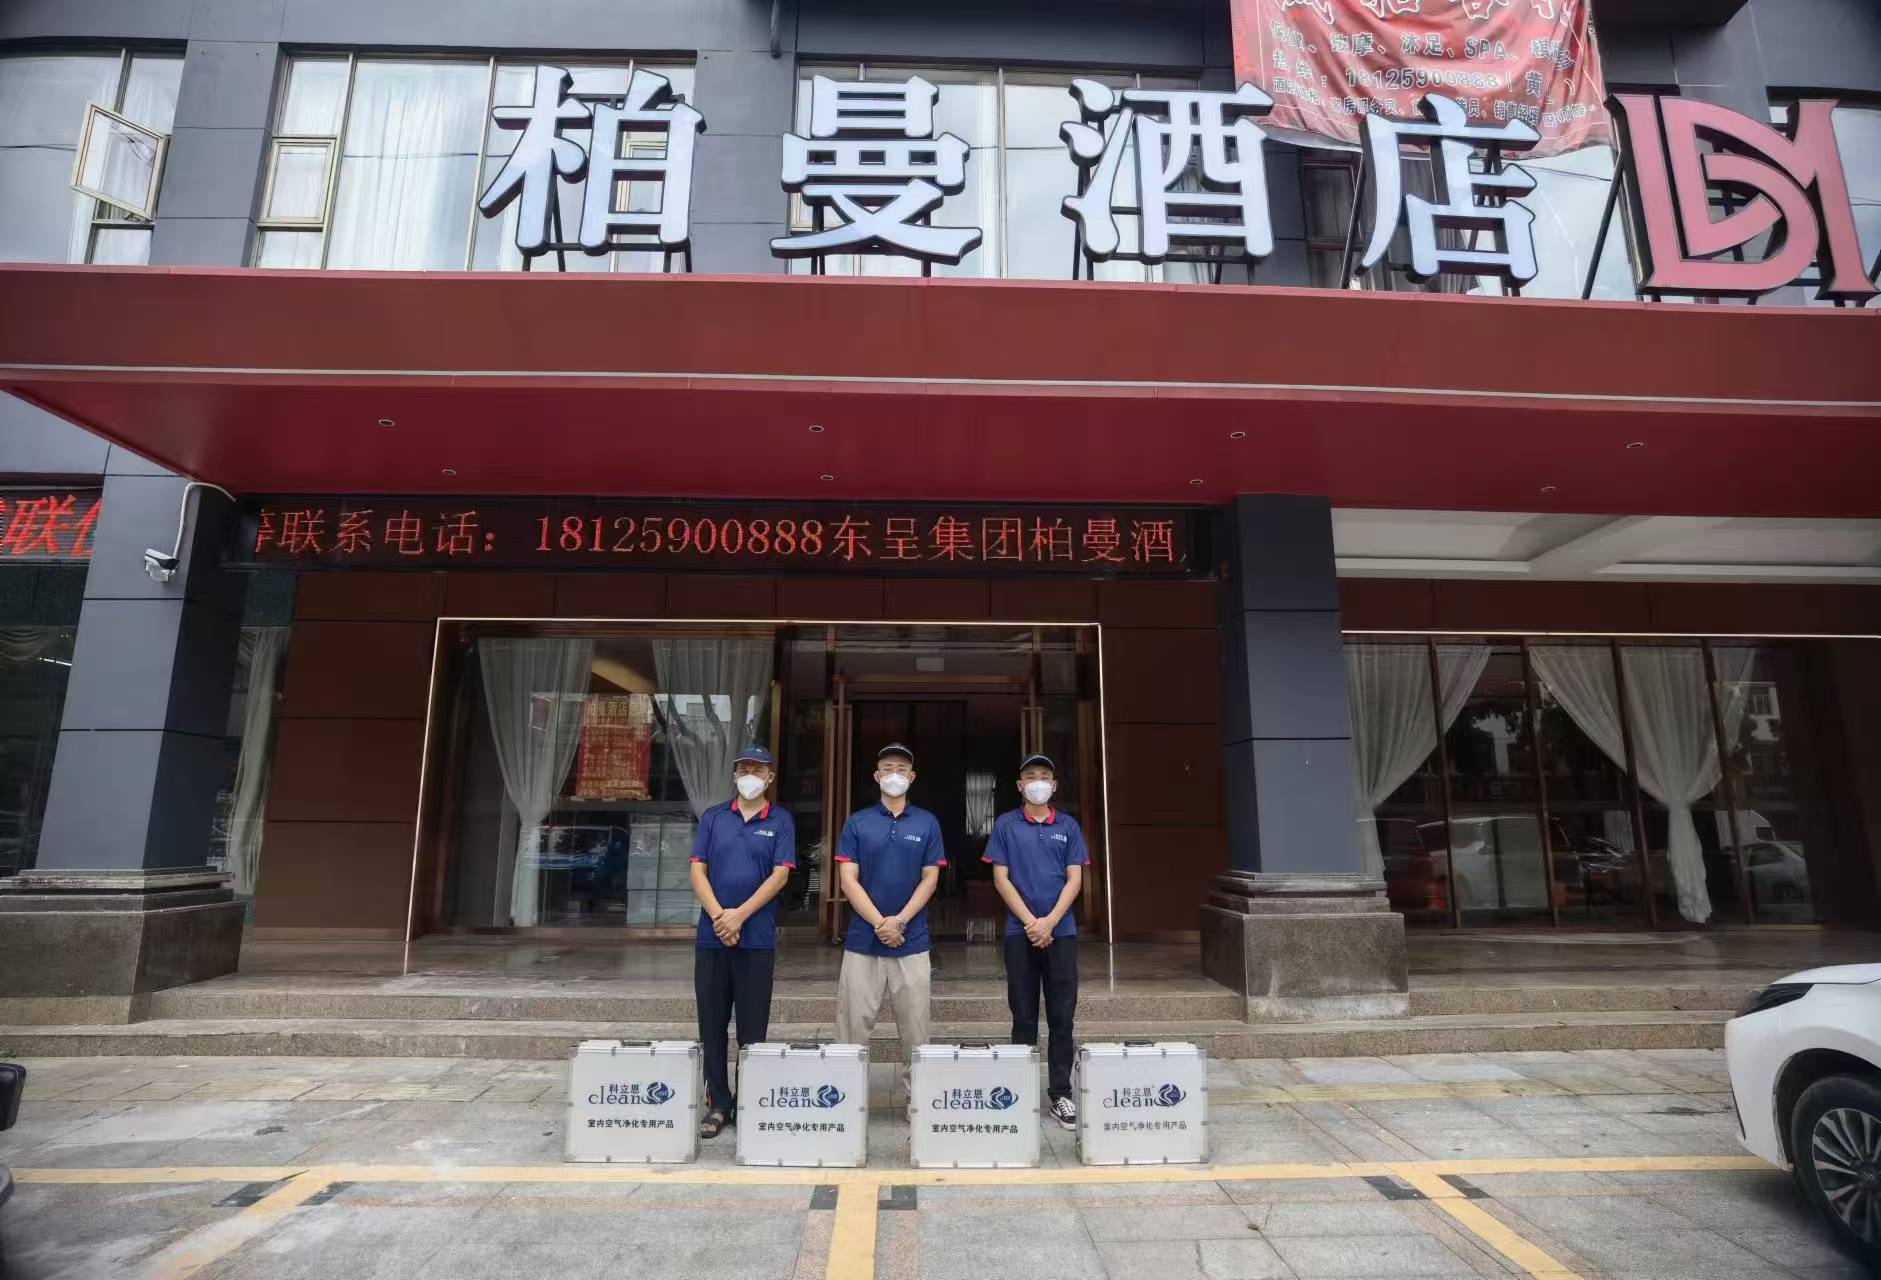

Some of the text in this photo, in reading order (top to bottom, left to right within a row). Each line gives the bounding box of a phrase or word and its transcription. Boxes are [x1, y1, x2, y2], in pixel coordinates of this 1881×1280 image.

[478, 64, 1541, 287] 柏曼酒店
[256, 509, 1187, 562] 联系电话：18125900888东呈集团柏曼酒
[588, 1085, 641, 1105] clean
[758, 1088, 812, 1108] clean
[932, 1090, 984, 1110] clean
[1102, 1089, 1154, 1108] clean
[588, 1118, 674, 1129] 室内空气净化专用产品
[758, 1122, 845, 1132] 室内空气净化专用产品
[931, 1123, 1018, 1134] 室内空气净化专用产品
